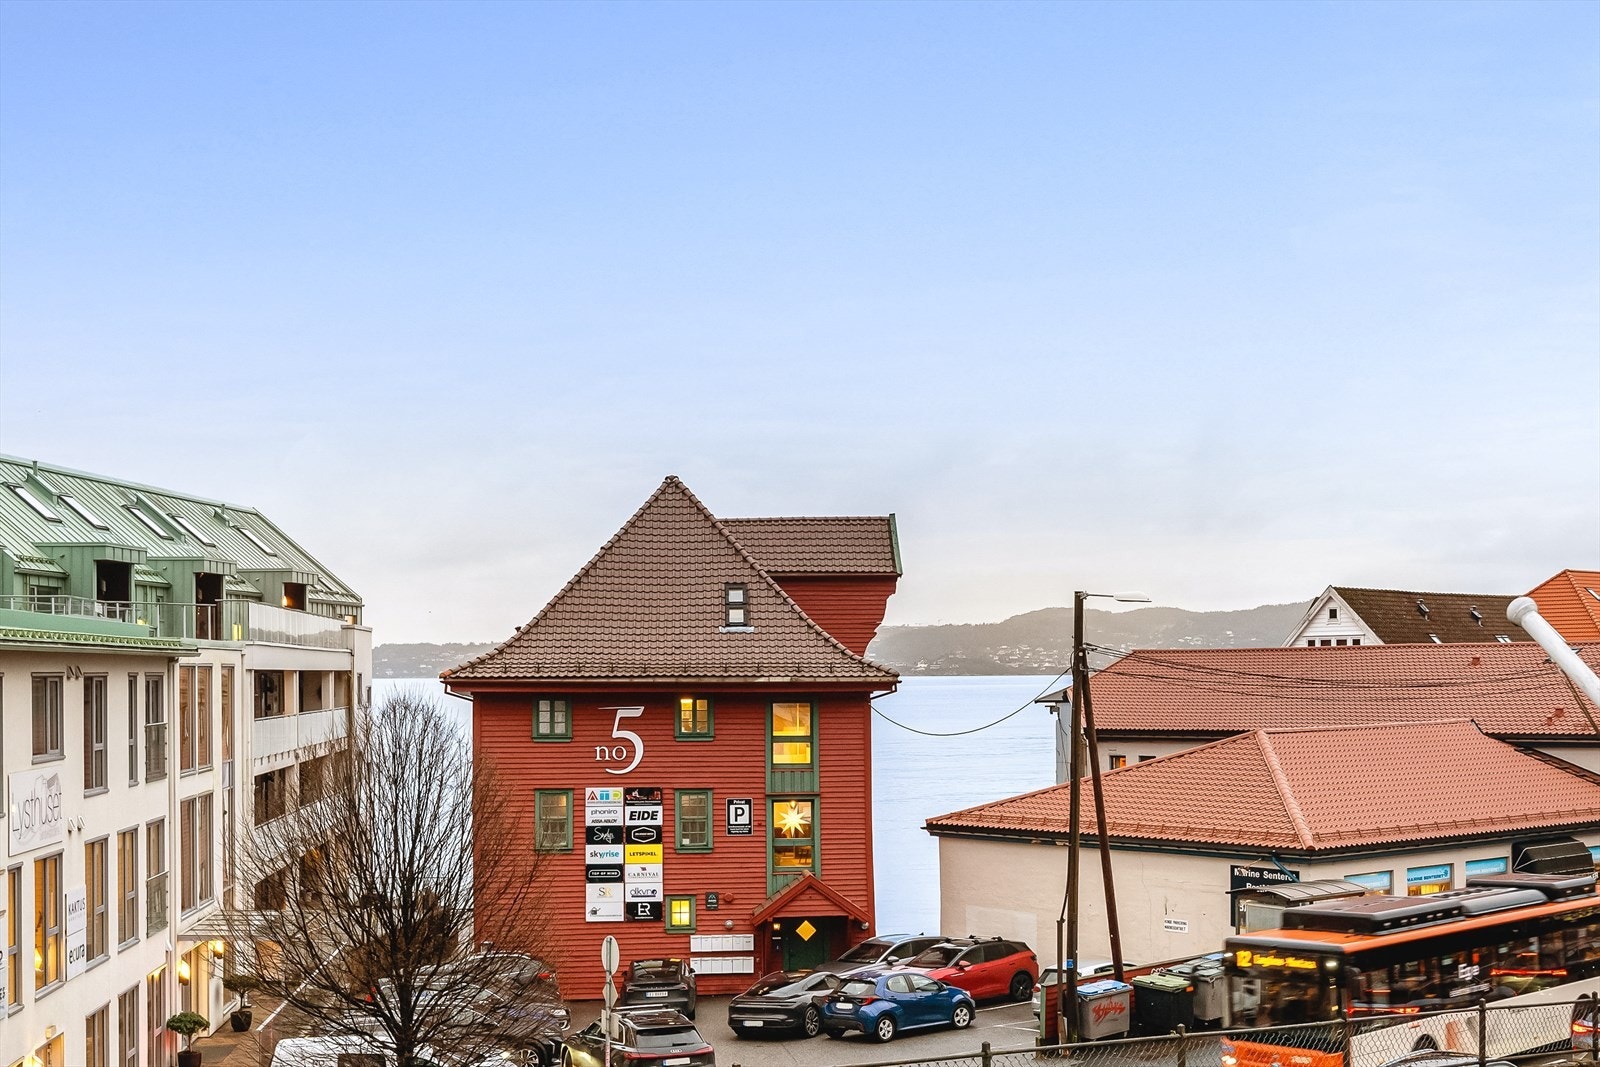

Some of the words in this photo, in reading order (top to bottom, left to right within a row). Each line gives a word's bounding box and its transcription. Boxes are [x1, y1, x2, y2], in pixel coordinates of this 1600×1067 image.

[598, 706, 645, 775] 5
[595, 745, 627, 761] no
[628, 810, 659, 821] EIDE
[734, 806, 746, 823] P
[589, 850, 620, 859] skyrise
[68, 898, 86, 915] KAKTUS
[69, 944, 85, 965] ecura
